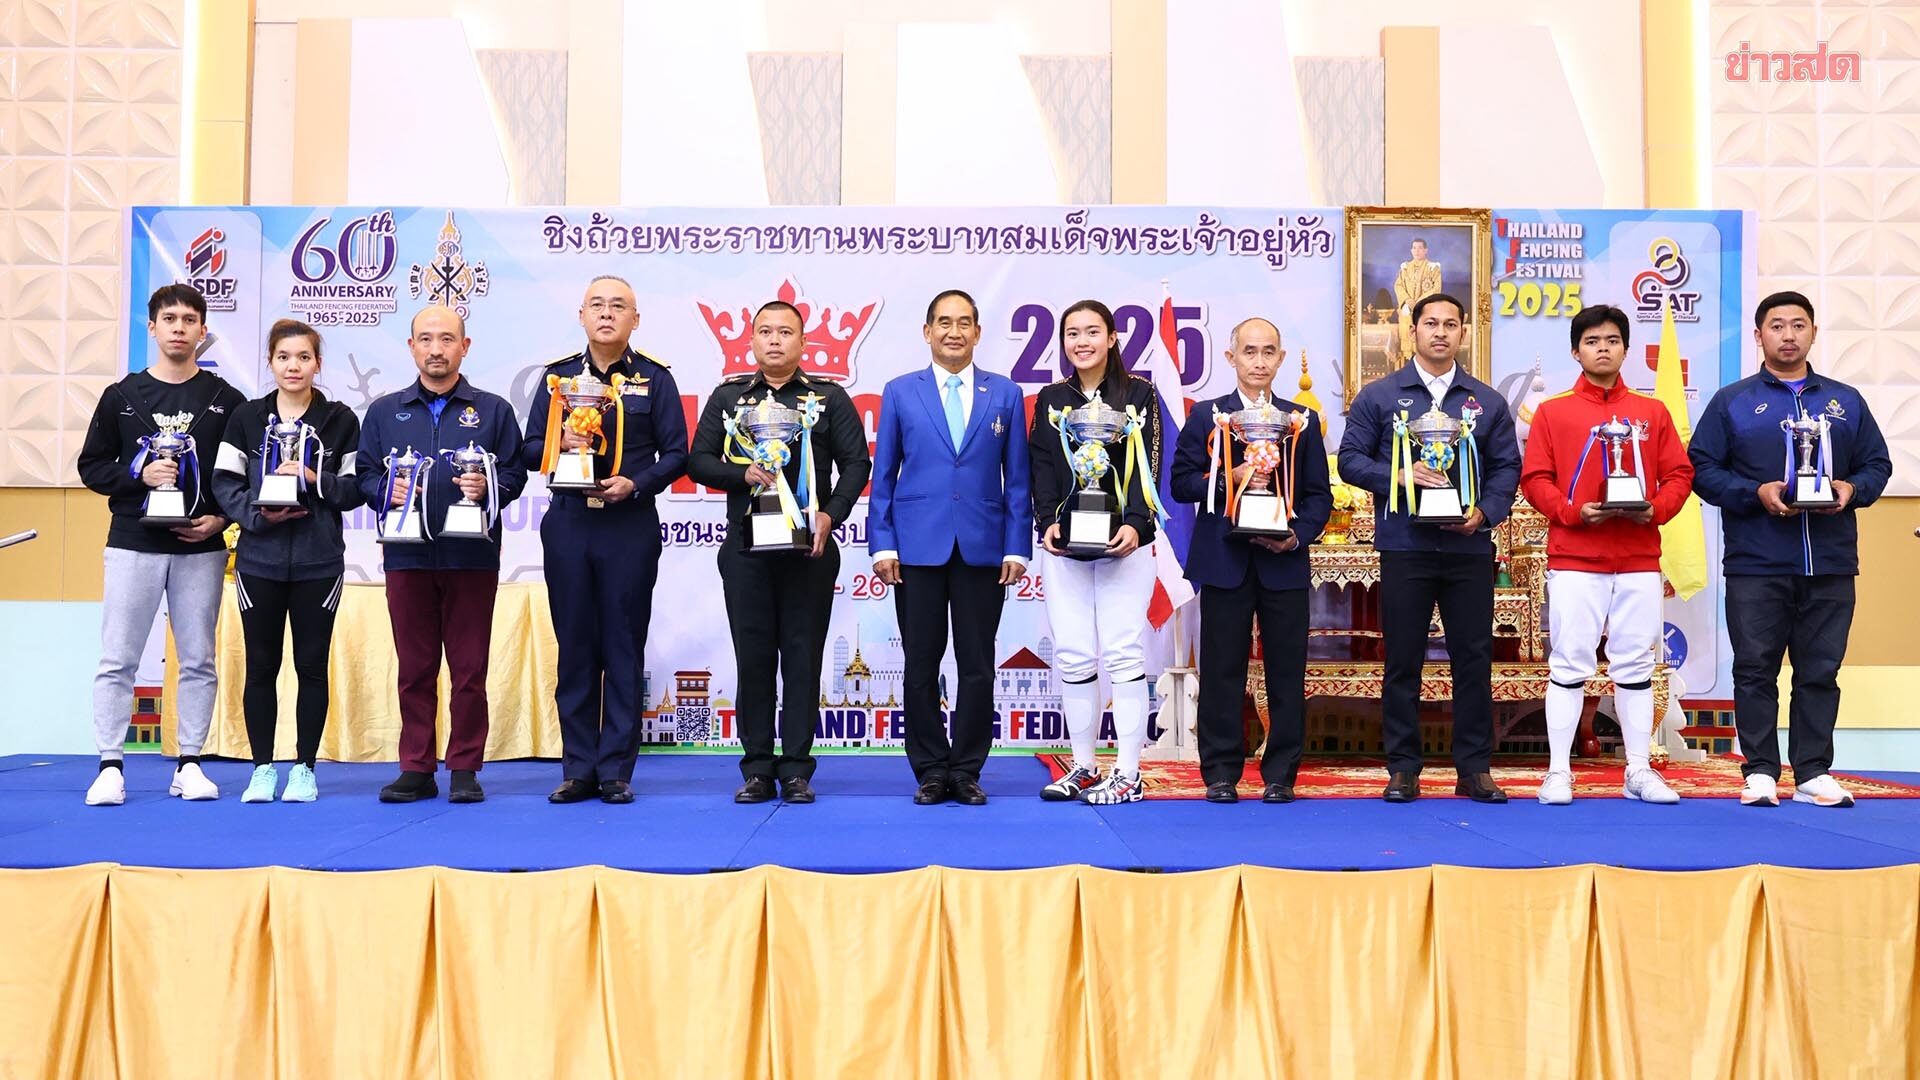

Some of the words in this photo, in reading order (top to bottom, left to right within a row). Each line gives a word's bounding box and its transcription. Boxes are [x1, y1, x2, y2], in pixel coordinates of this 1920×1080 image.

[543, 210, 1334, 266] ชิงถ้วยพระราชทานพระบาทสมเด็จพระเจ้าอยู่หัว
[1495, 218, 1583, 239] THAILAND
[1509, 239, 1583, 258] FENCING
[1505, 258, 1583, 279] FESTIVAL
[187, 278, 234, 296] SDF
[290, 285, 394, 298] ANNIVERSARY
[1498, 282, 1583, 318] 2025
[306, 312, 378, 324] 1965-2025
[1010, 304, 1205, 386] 225
